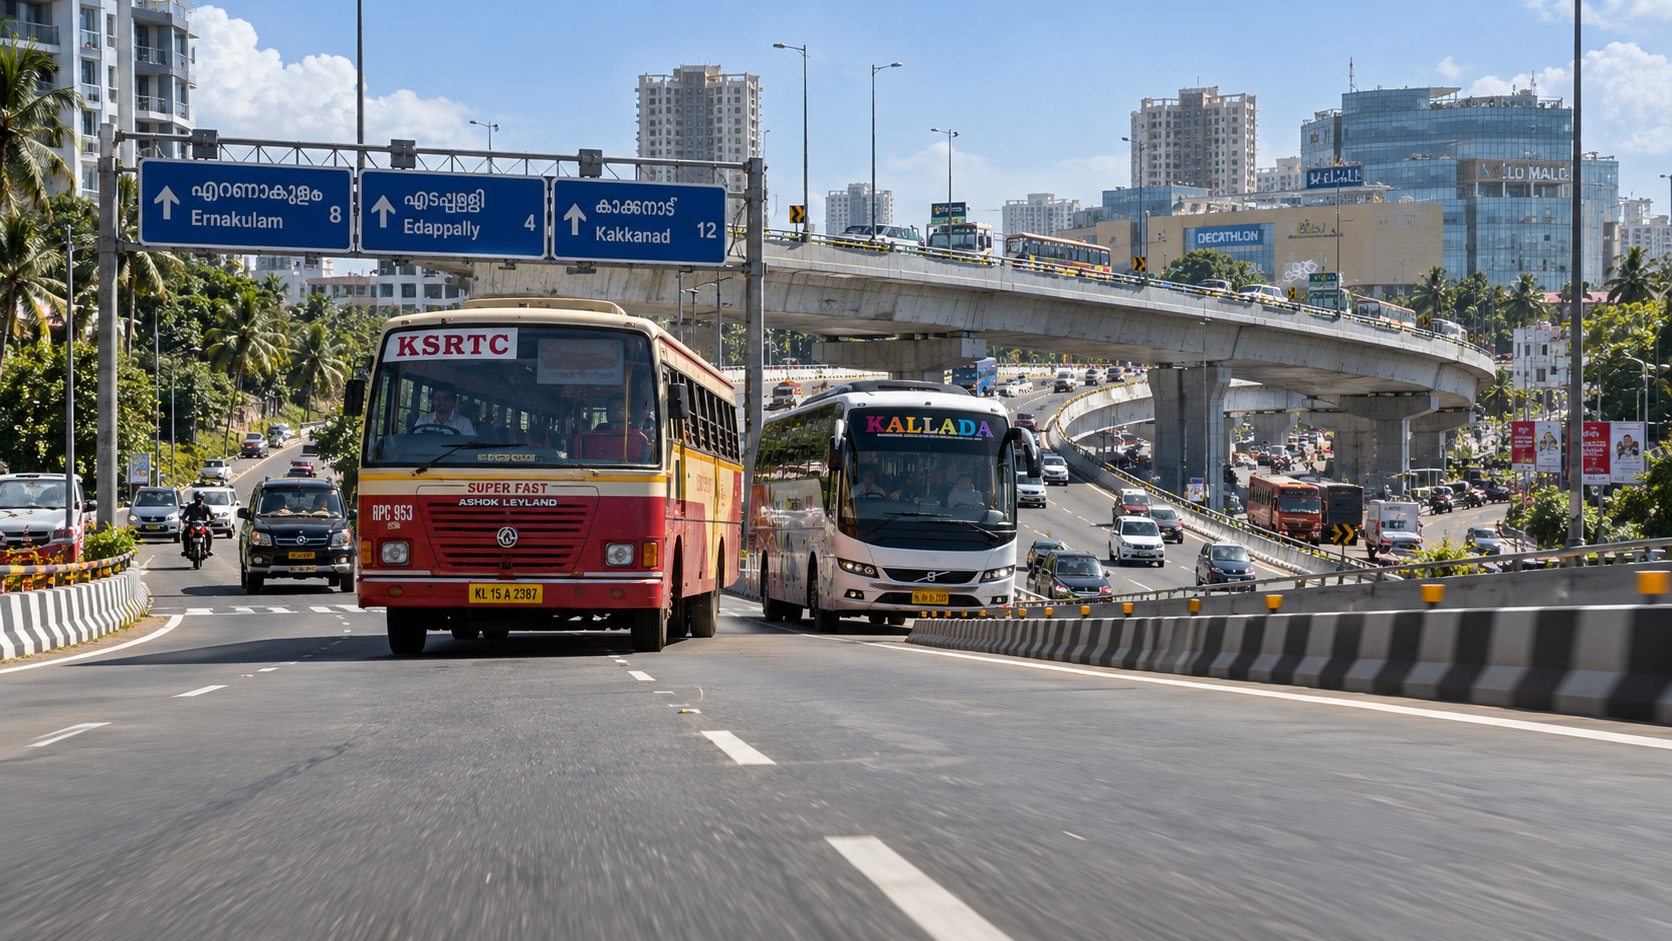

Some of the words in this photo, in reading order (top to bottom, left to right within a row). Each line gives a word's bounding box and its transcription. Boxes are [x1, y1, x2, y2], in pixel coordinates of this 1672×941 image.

[329, 205, 342, 223] 8
[595, 197, 678, 217] കാക്കനാട്
[191, 210, 283, 229] Ernakulam
[524, 214, 536, 231] 4
[404, 218, 480, 241] Edappally
[596, 226, 670, 244] Kakkanad
[697, 221, 717, 239] 12
[1197, 230, 1259, 243] DECATHLON
[396, 334, 509, 357] KSRTC
[865, 415, 995, 438] KALLADA
[467, 482, 511, 494] SUPER
[514, 482, 549, 494] FAST
[458, 498, 500, 507] ASHOK
[502, 498, 558, 507] LEYLAND
[372, 504, 391, 521] RPC
[394, 504, 413, 521] 953
[475, 588, 488, 600] KL
[503, 588, 511, 600] A
[513, 588, 538, 600] 2387
